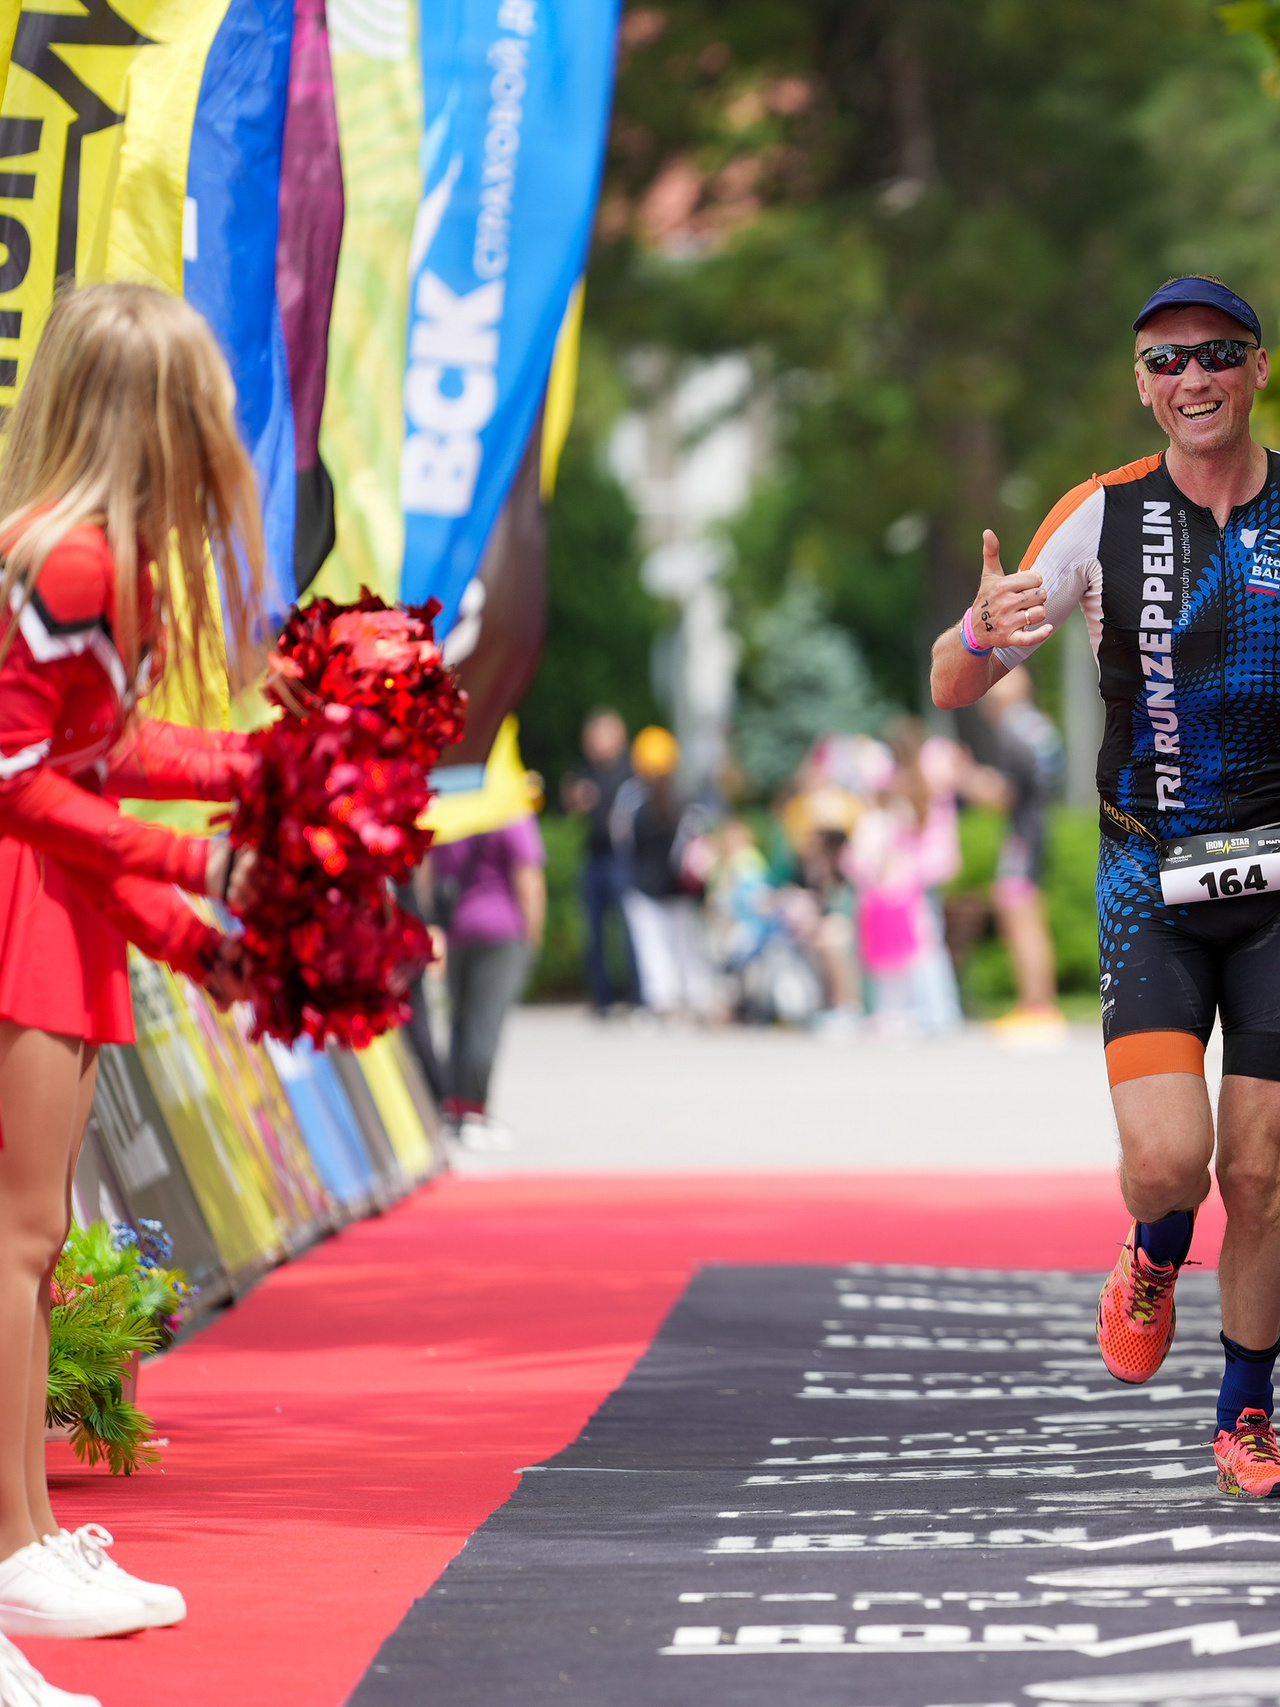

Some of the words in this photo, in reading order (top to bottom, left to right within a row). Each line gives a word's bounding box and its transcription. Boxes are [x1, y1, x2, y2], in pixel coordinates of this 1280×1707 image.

[1177, 509, 1188, 528] club
[1182, 528, 1192, 564] triathlon
[1178, 567, 1192, 626] Dolgoprudny
[1155, 763, 1186, 812] TRI
[1206, 840, 1224, 851] IRON
[1231, 837, 1250, 846] STAR
[1199, 864, 1269, 899] 164
[745, 1465, 1077, 1484] IRON
[715, 1527, 1089, 1549] IRON
[672, 1623, 1099, 1645] IRON
